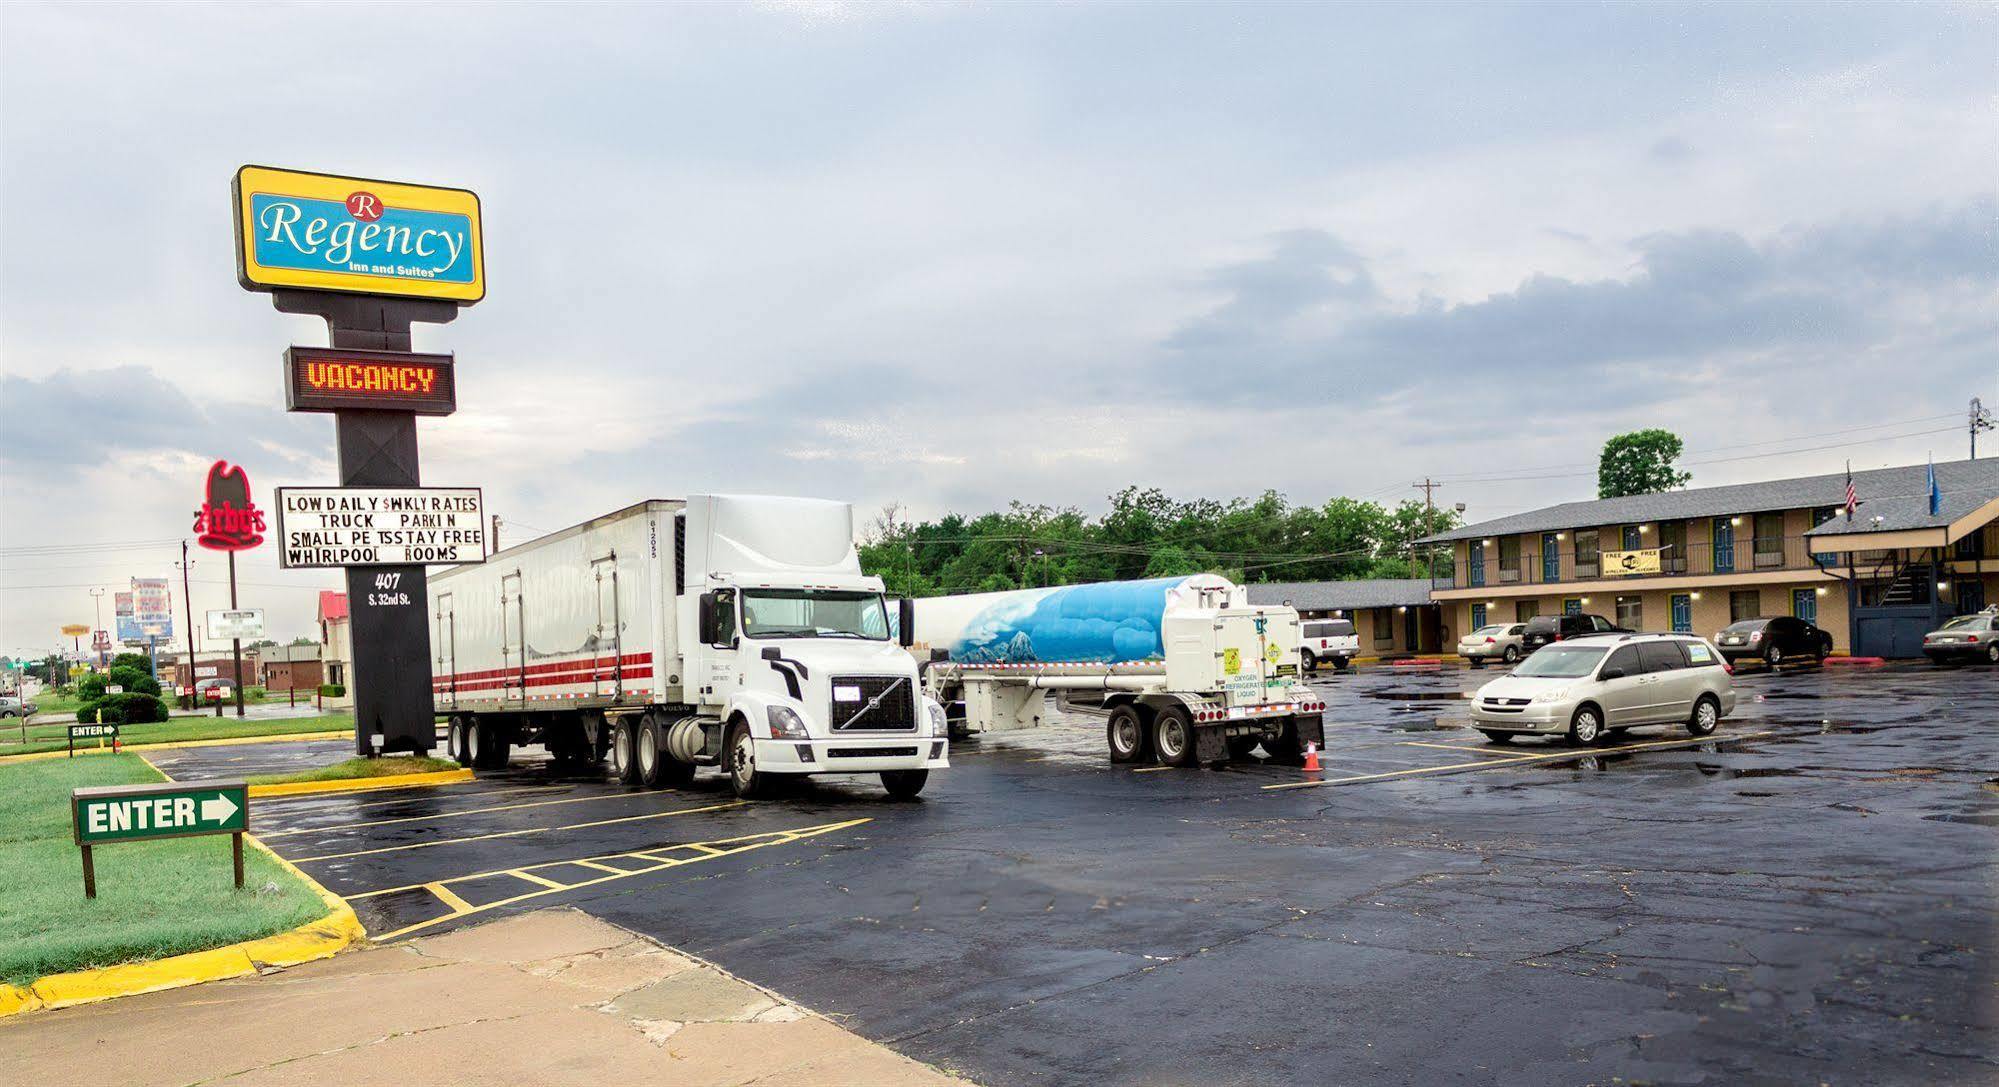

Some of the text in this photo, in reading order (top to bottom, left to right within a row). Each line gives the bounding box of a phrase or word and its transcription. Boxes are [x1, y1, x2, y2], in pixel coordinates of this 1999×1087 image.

[351, 195, 380, 218] R
[261, 202, 463, 273] Regency
[349, 261, 435, 278] Inn and Suites
[307, 362, 435, 392] VACANCY
[287, 497, 322, 511] LOW
[327, 497, 378, 511] DAILY
[432, 497, 478, 511] RATES
[193, 501, 267, 540] Arby's
[319, 514, 374, 528] TRUCK
[291, 531, 342, 546] SMALL
[443, 530, 481, 543] FREE
[288, 547, 457, 563] WHIRLPOOL ROOMS
[375, 572, 401, 590] 407
[368, 592, 411, 606] S. 32nd St.
[1237, 690, 1256, 698] LIQUID
[72, 726, 103, 736] ENTER
[88, 797, 196, 834] ENTER
